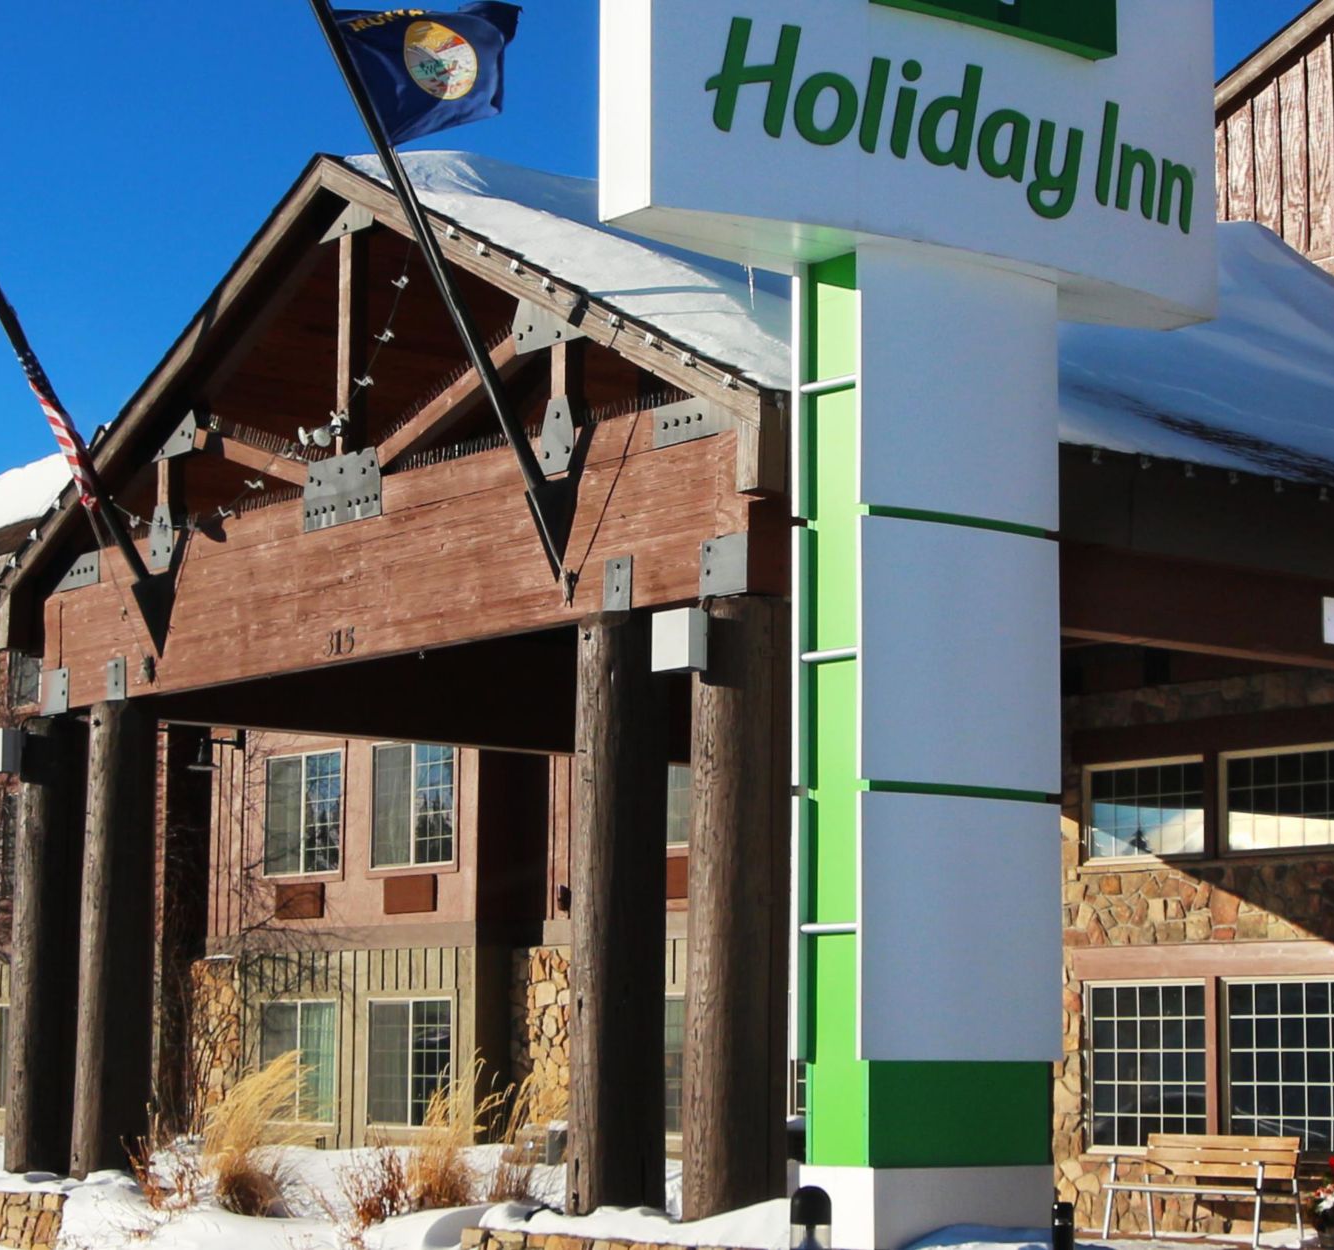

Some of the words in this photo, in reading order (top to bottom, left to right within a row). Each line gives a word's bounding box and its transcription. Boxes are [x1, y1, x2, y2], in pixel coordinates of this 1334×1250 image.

[704, 17, 1084, 220] Holiday
[1095, 101, 1194, 235] Inn
[323, 625, 355, 657] 315
